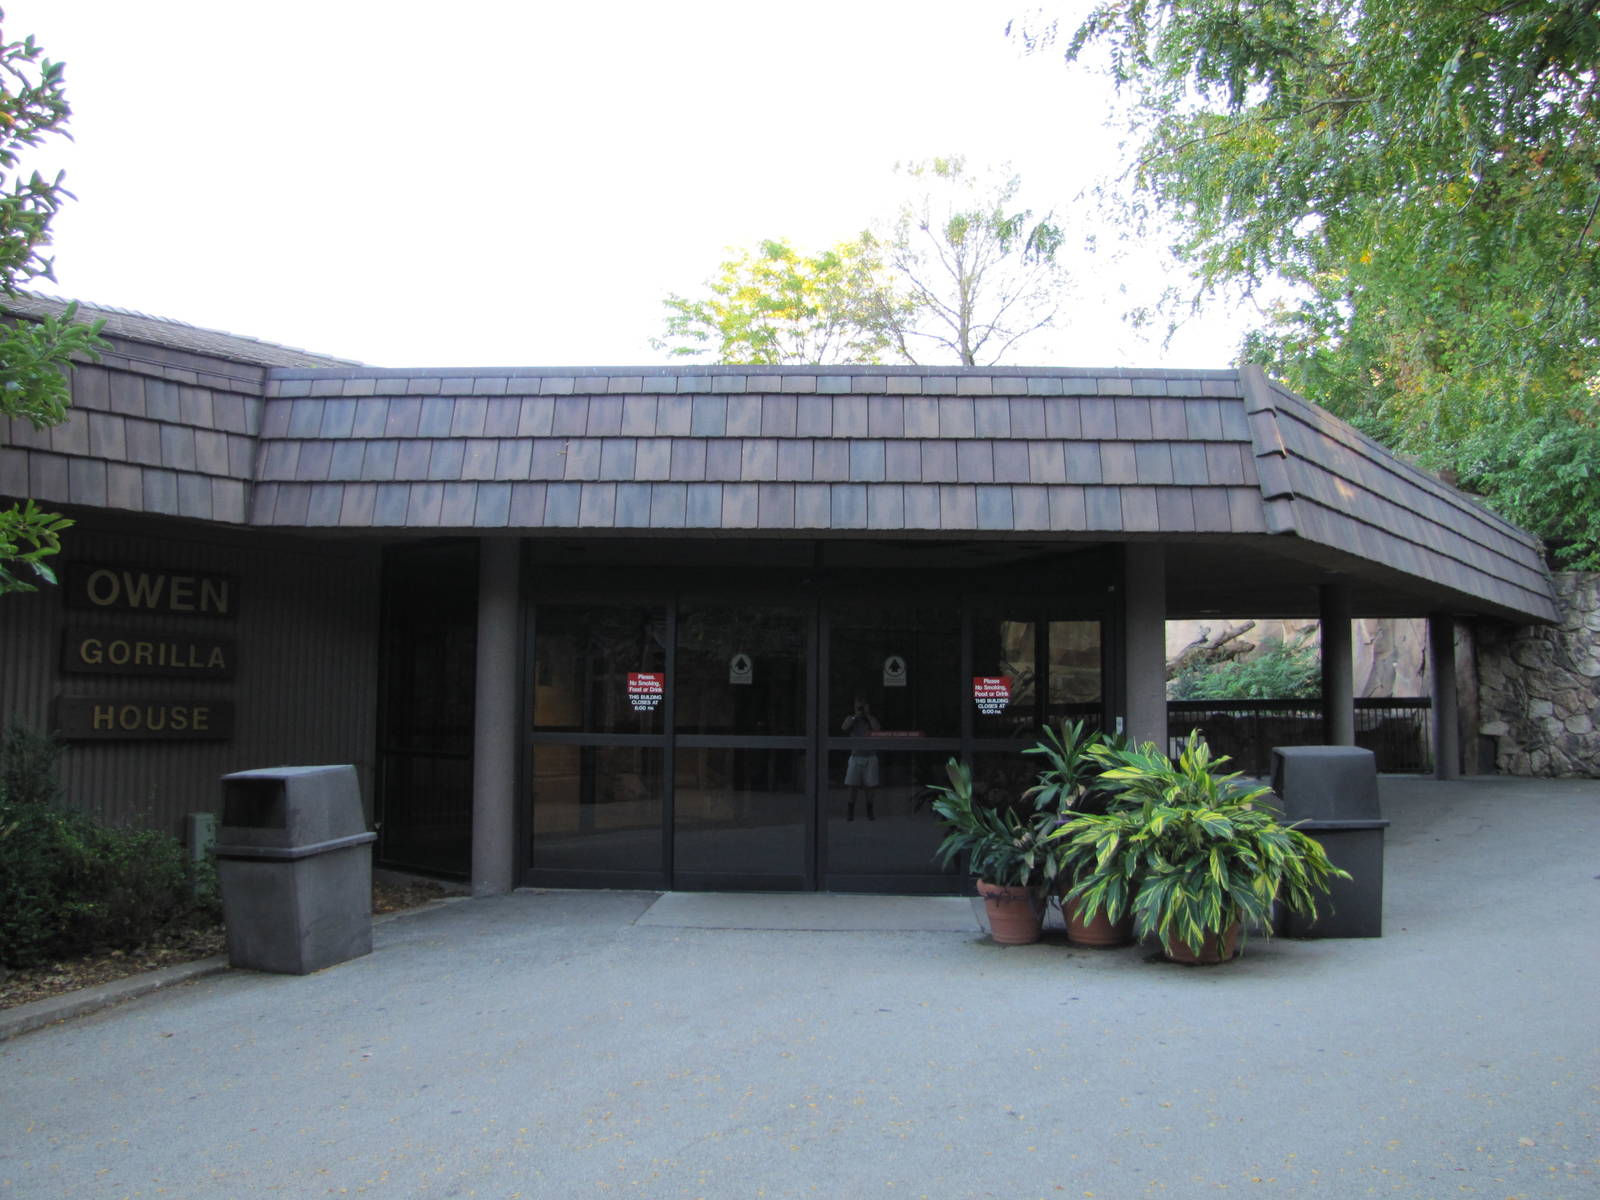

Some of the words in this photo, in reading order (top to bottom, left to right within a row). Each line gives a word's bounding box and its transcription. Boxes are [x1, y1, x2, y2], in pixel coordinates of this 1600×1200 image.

[86, 569, 229, 613] OWEN
[80, 638, 225, 669] GORILLA
[93, 704, 209, 731] HOUSE
